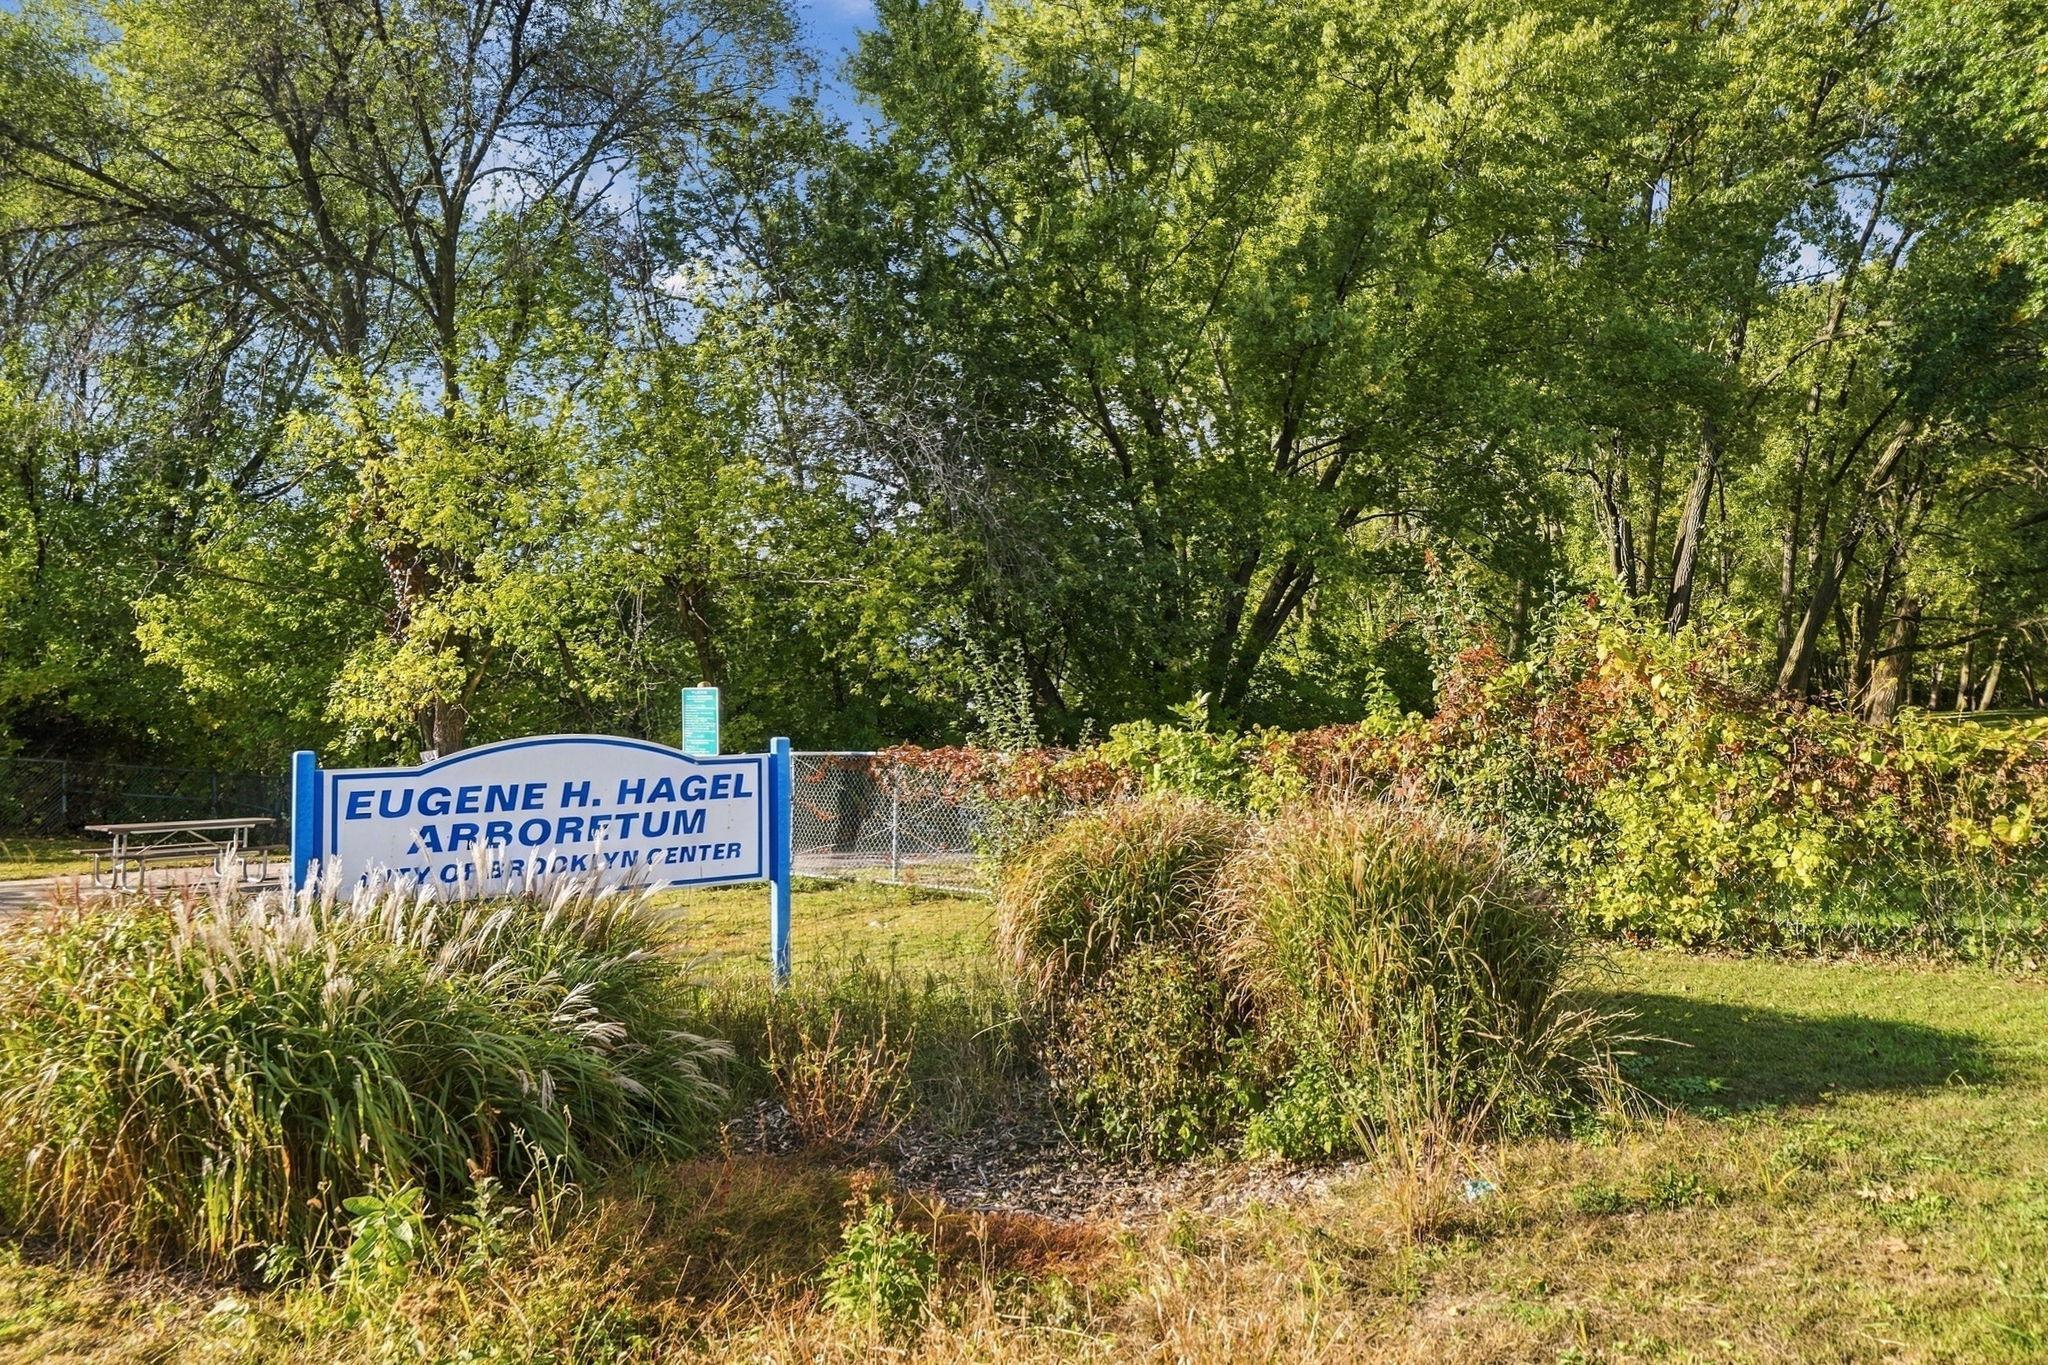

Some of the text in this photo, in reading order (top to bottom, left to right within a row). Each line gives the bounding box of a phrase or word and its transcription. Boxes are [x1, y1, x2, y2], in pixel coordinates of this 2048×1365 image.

[345, 772, 754, 820] EUGENE H. HAGEL
[407, 808, 707, 855] ARBORETUM
[440, 862, 477, 883] OF
[646, 842, 742, 866] CENTER
